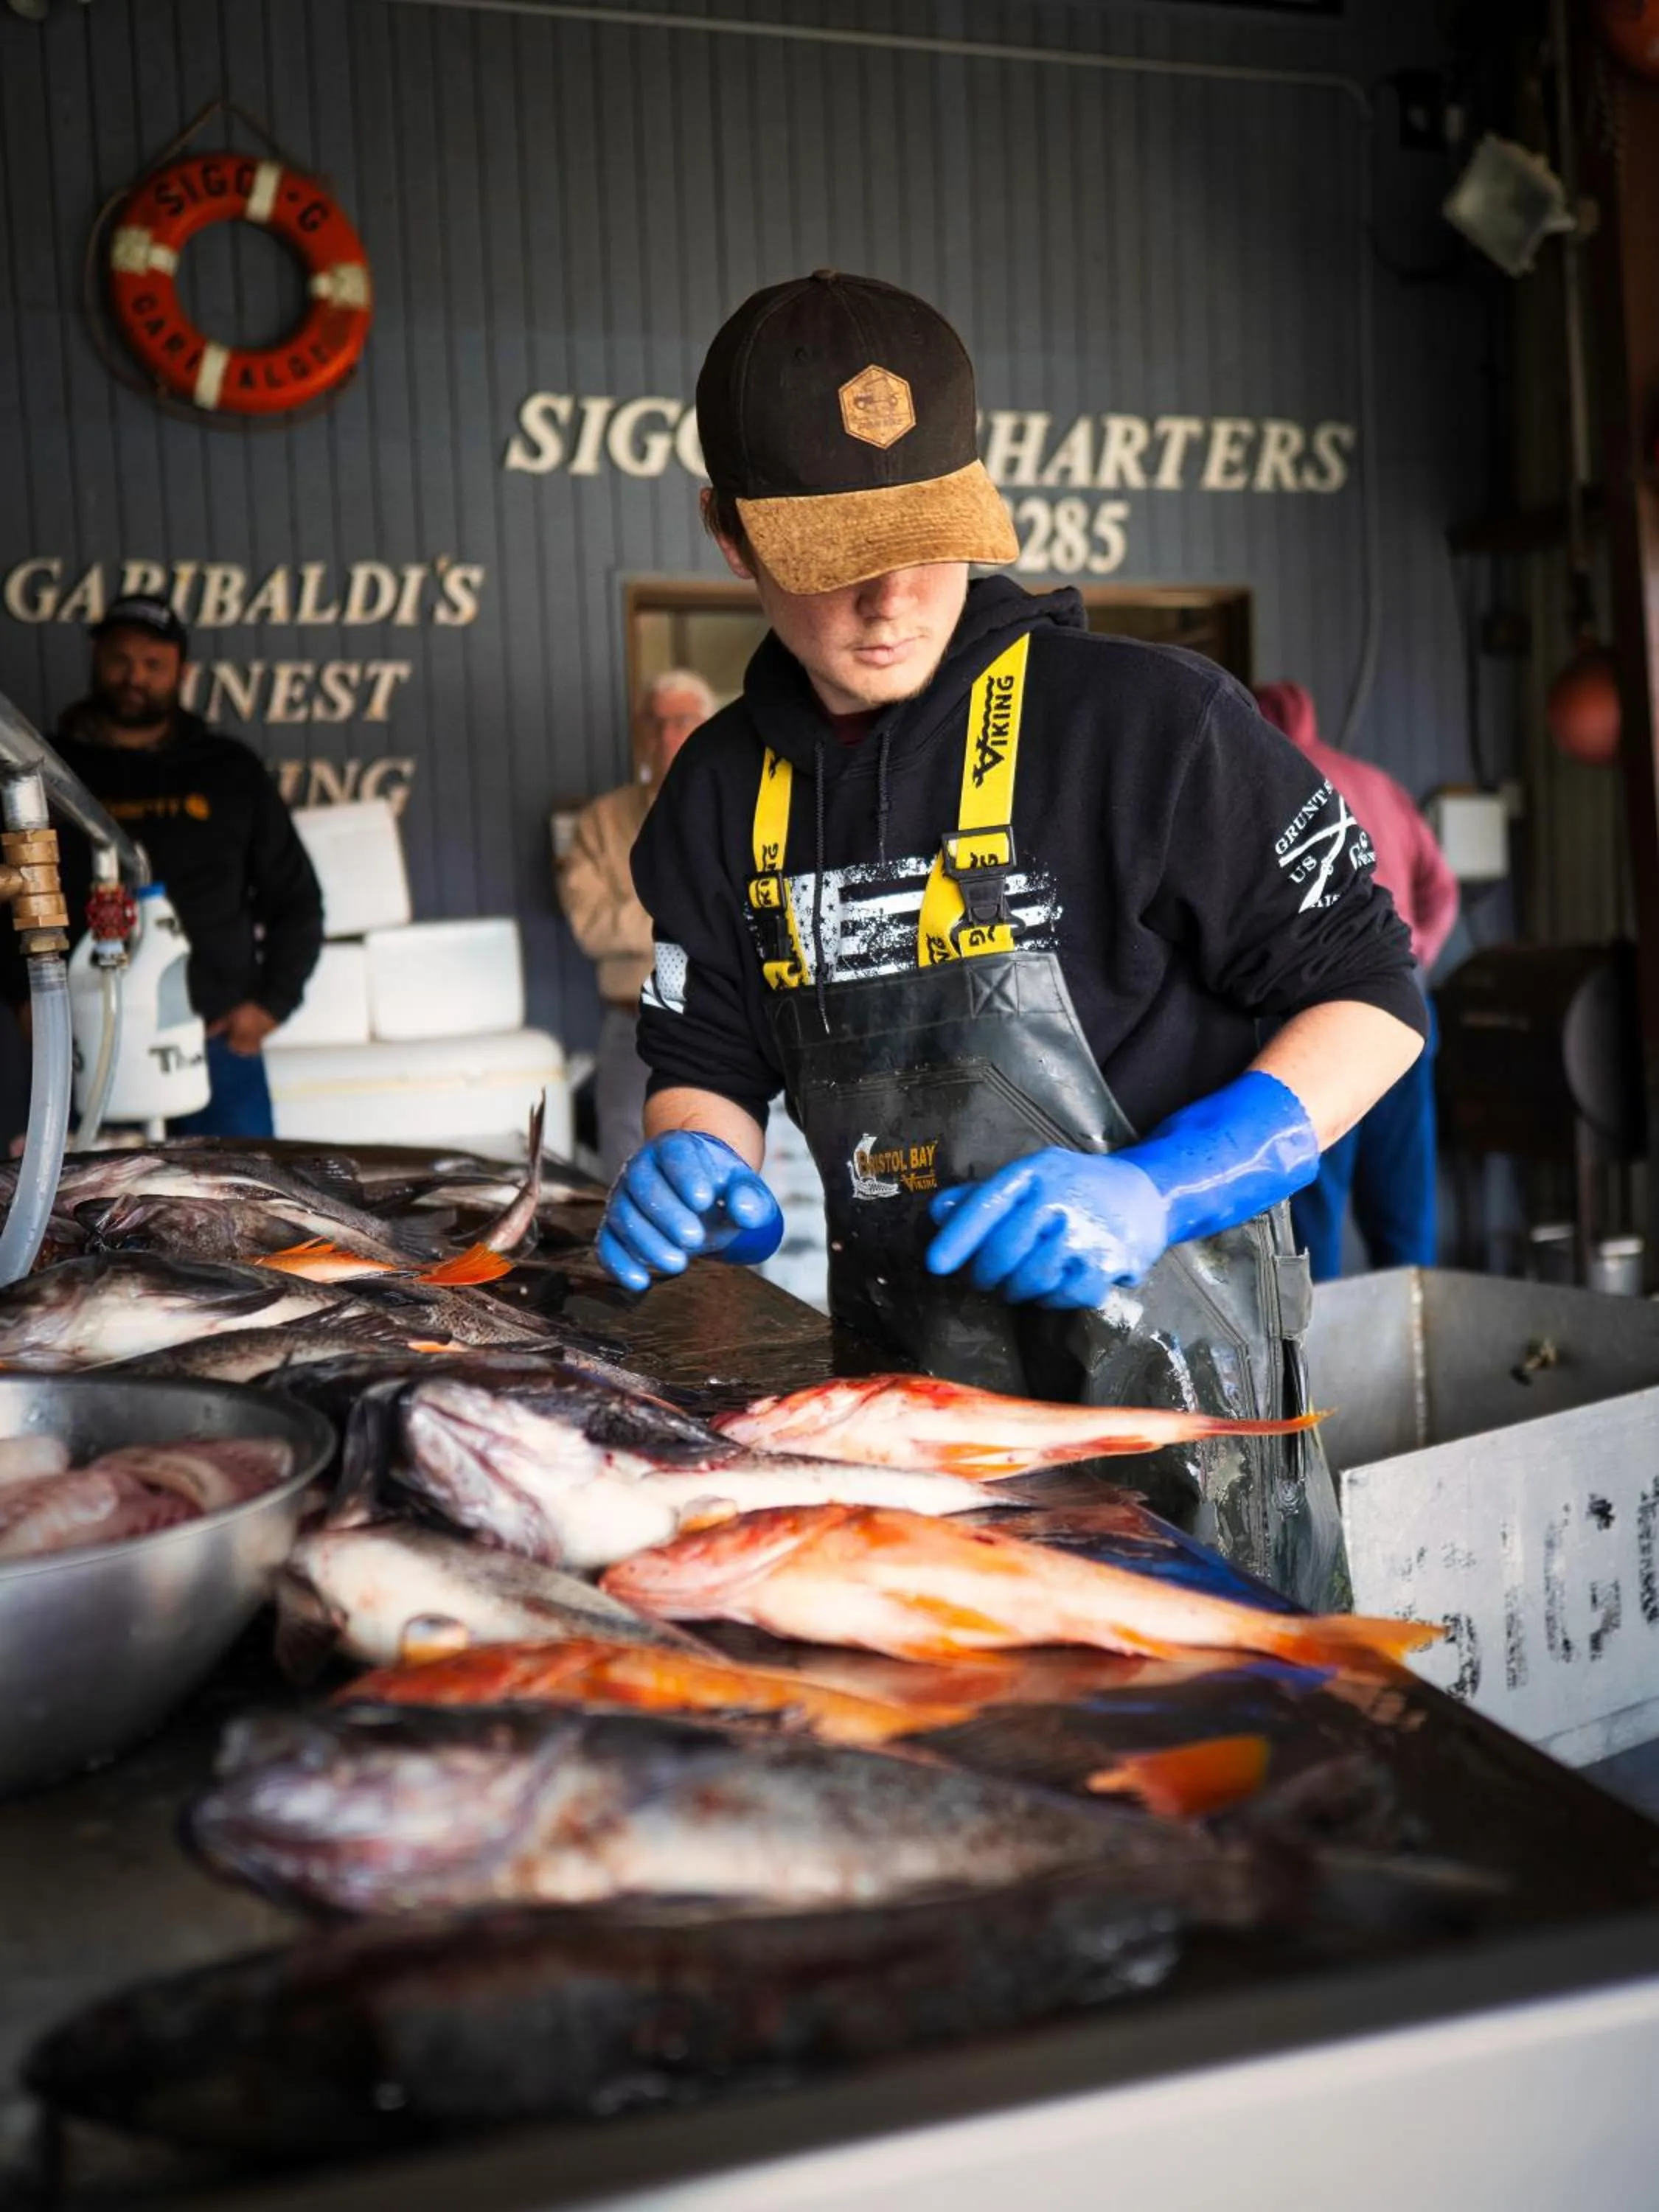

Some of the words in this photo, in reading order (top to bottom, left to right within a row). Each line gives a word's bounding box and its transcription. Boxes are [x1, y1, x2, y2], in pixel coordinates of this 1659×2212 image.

[975, 408, 1355, 493] HARTERS
[178, 658, 411, 723] INEST
[267, 757, 415, 817] ING
[1290, 855, 1318, 884] US
[909, 1142, 935, 1169] BAY
